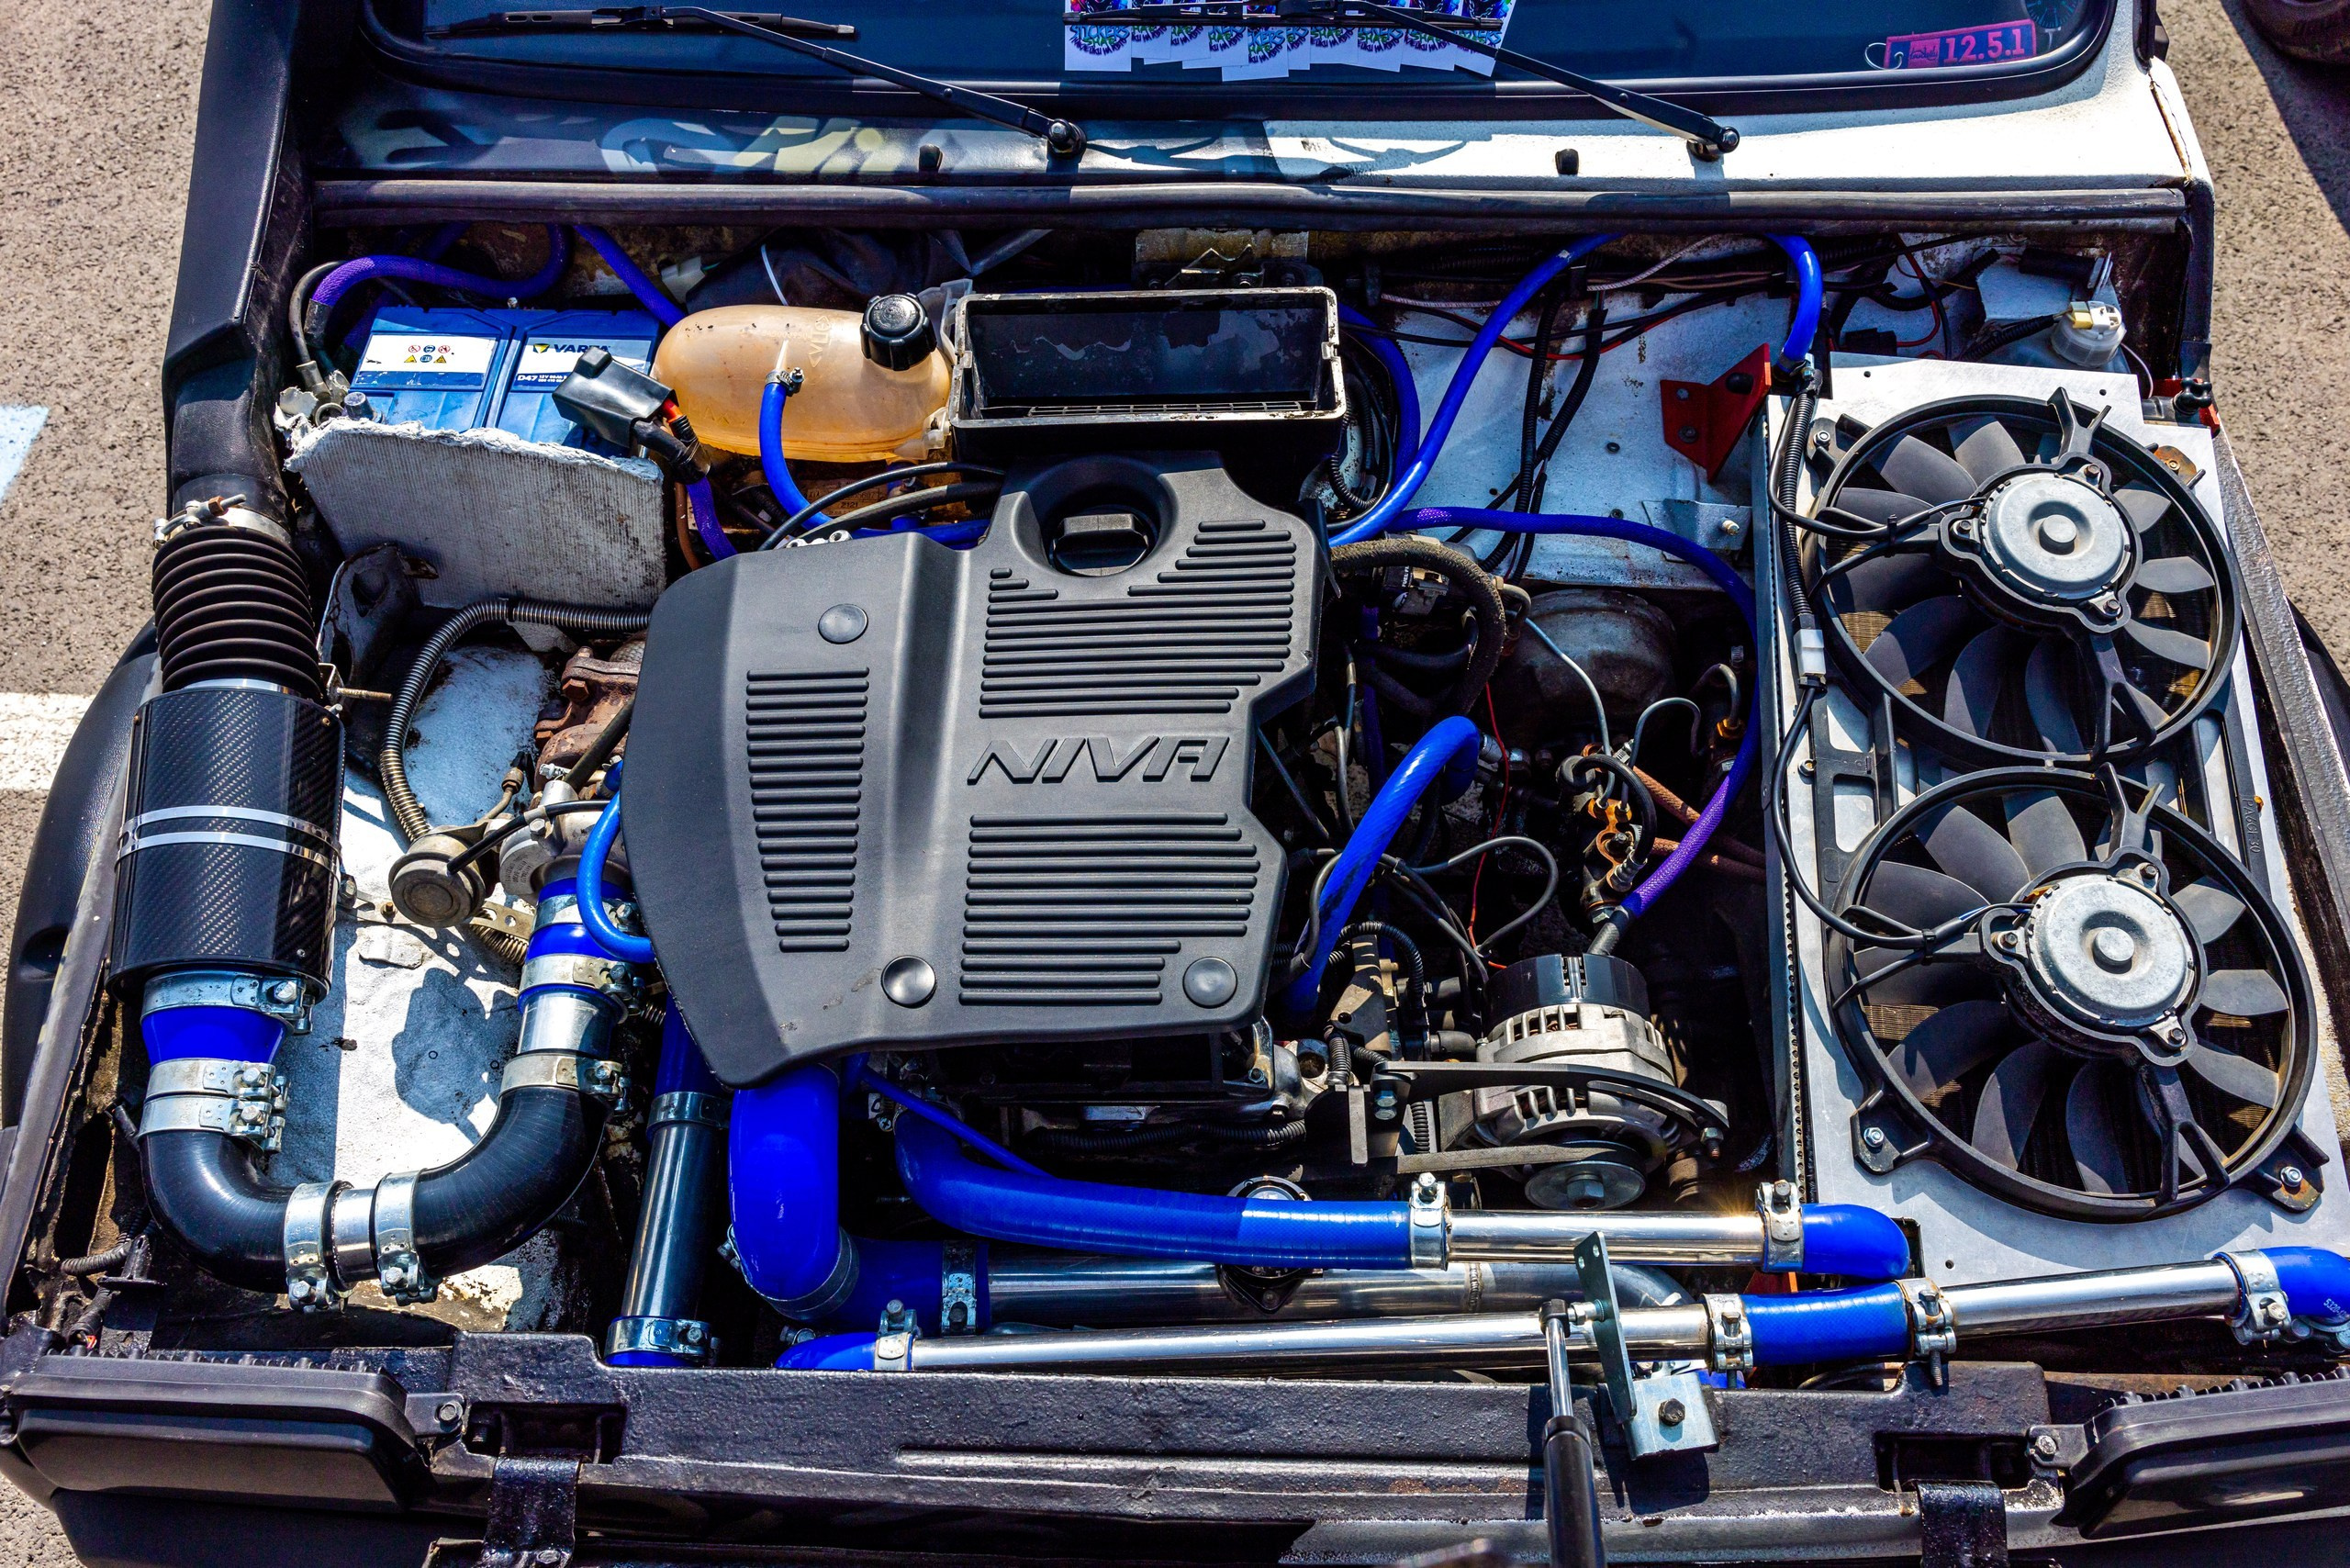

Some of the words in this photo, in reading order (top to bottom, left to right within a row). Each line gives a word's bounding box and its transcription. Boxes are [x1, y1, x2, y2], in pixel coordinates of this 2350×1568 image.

[1943, 28, 2025, 63] 12.5.1
[554, 344, 609, 353] VARA
[967, 736, 1230, 785] NIVA
